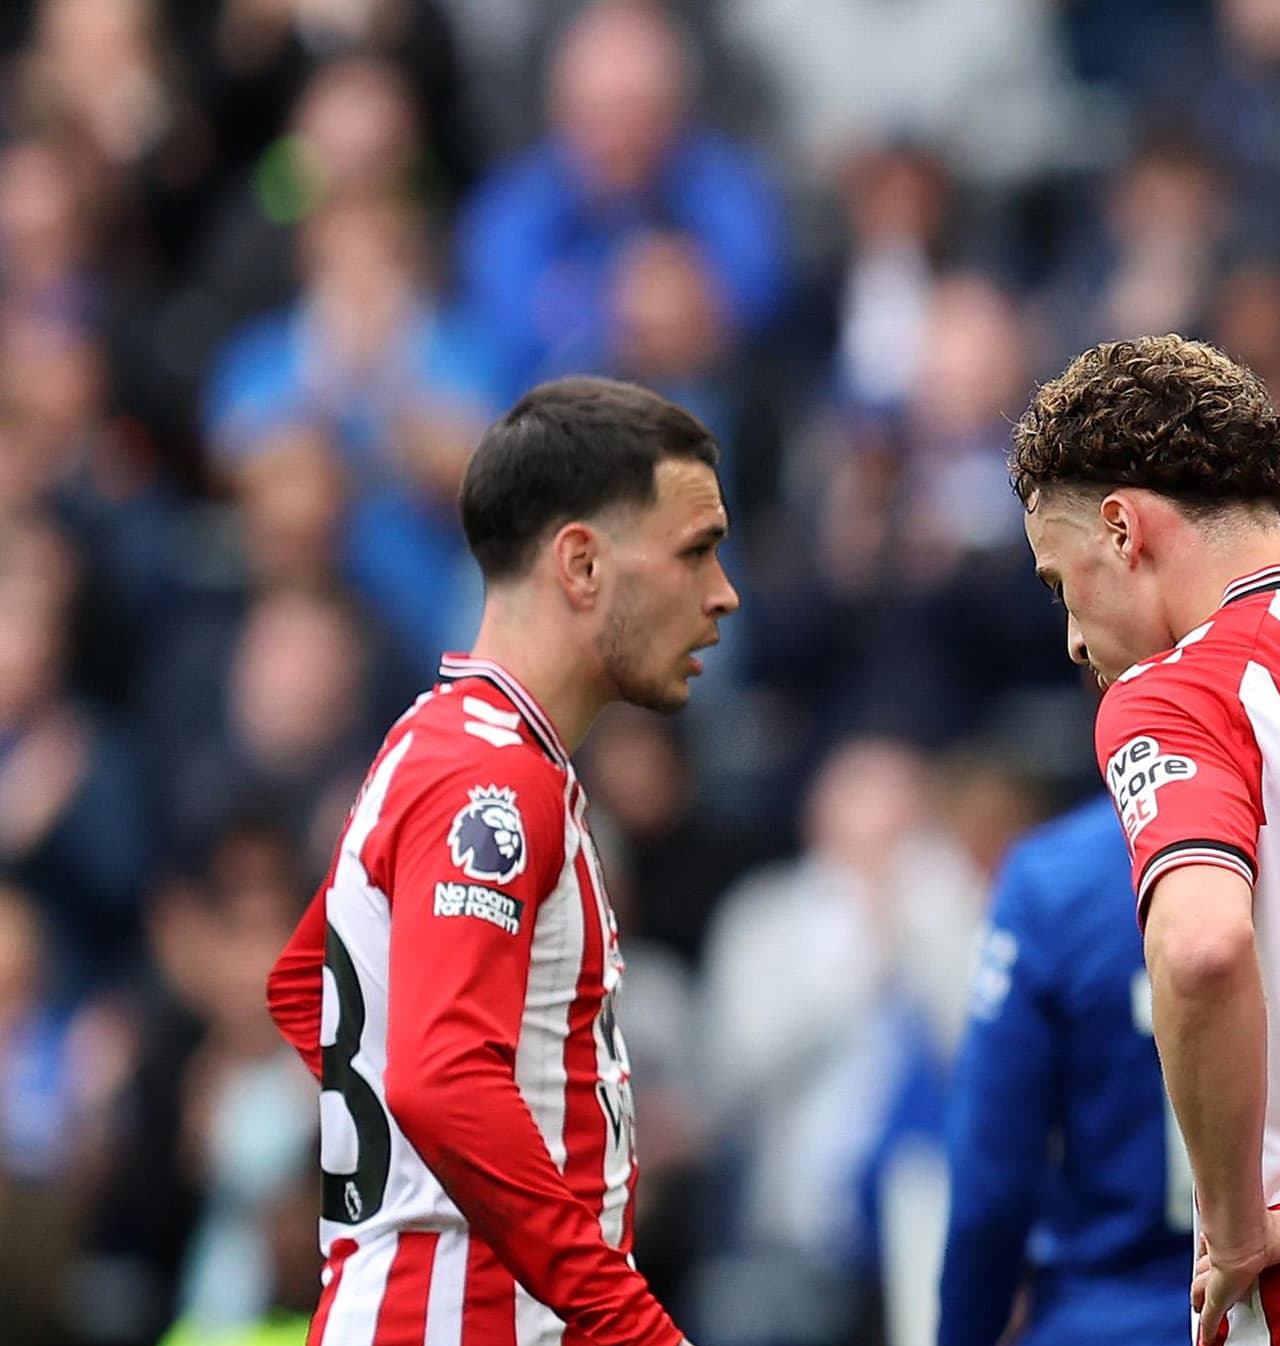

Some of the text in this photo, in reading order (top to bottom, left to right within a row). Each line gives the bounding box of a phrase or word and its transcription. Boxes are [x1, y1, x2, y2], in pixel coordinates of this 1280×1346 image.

[1110, 741, 1151, 790] ive
[1119, 760, 1188, 812] core
[1127, 799, 1151, 837] et
